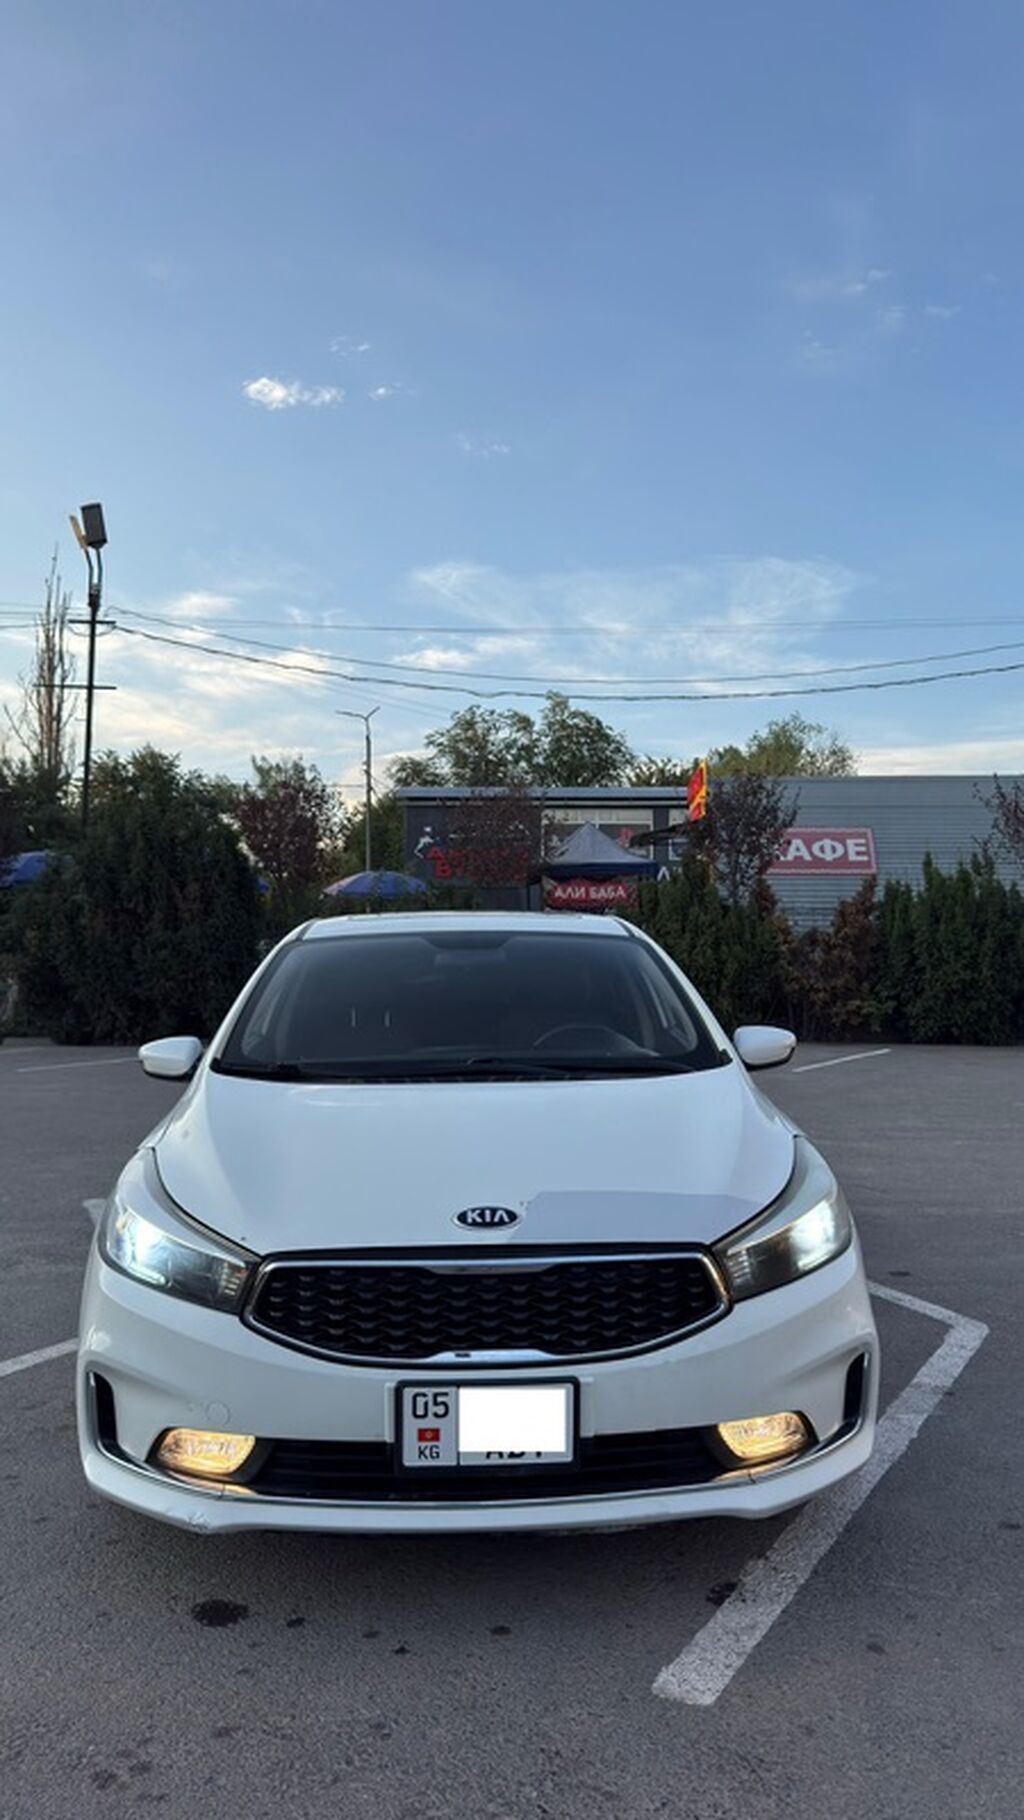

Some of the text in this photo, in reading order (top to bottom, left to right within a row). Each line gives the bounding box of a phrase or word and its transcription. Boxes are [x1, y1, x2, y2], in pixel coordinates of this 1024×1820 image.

[555, 885, 627, 899] АЛИ БАБА
[466, 1209, 510, 1223] KIA
[412, 1391, 450, 1419] 05
[417, 1444, 441, 1460] KG
